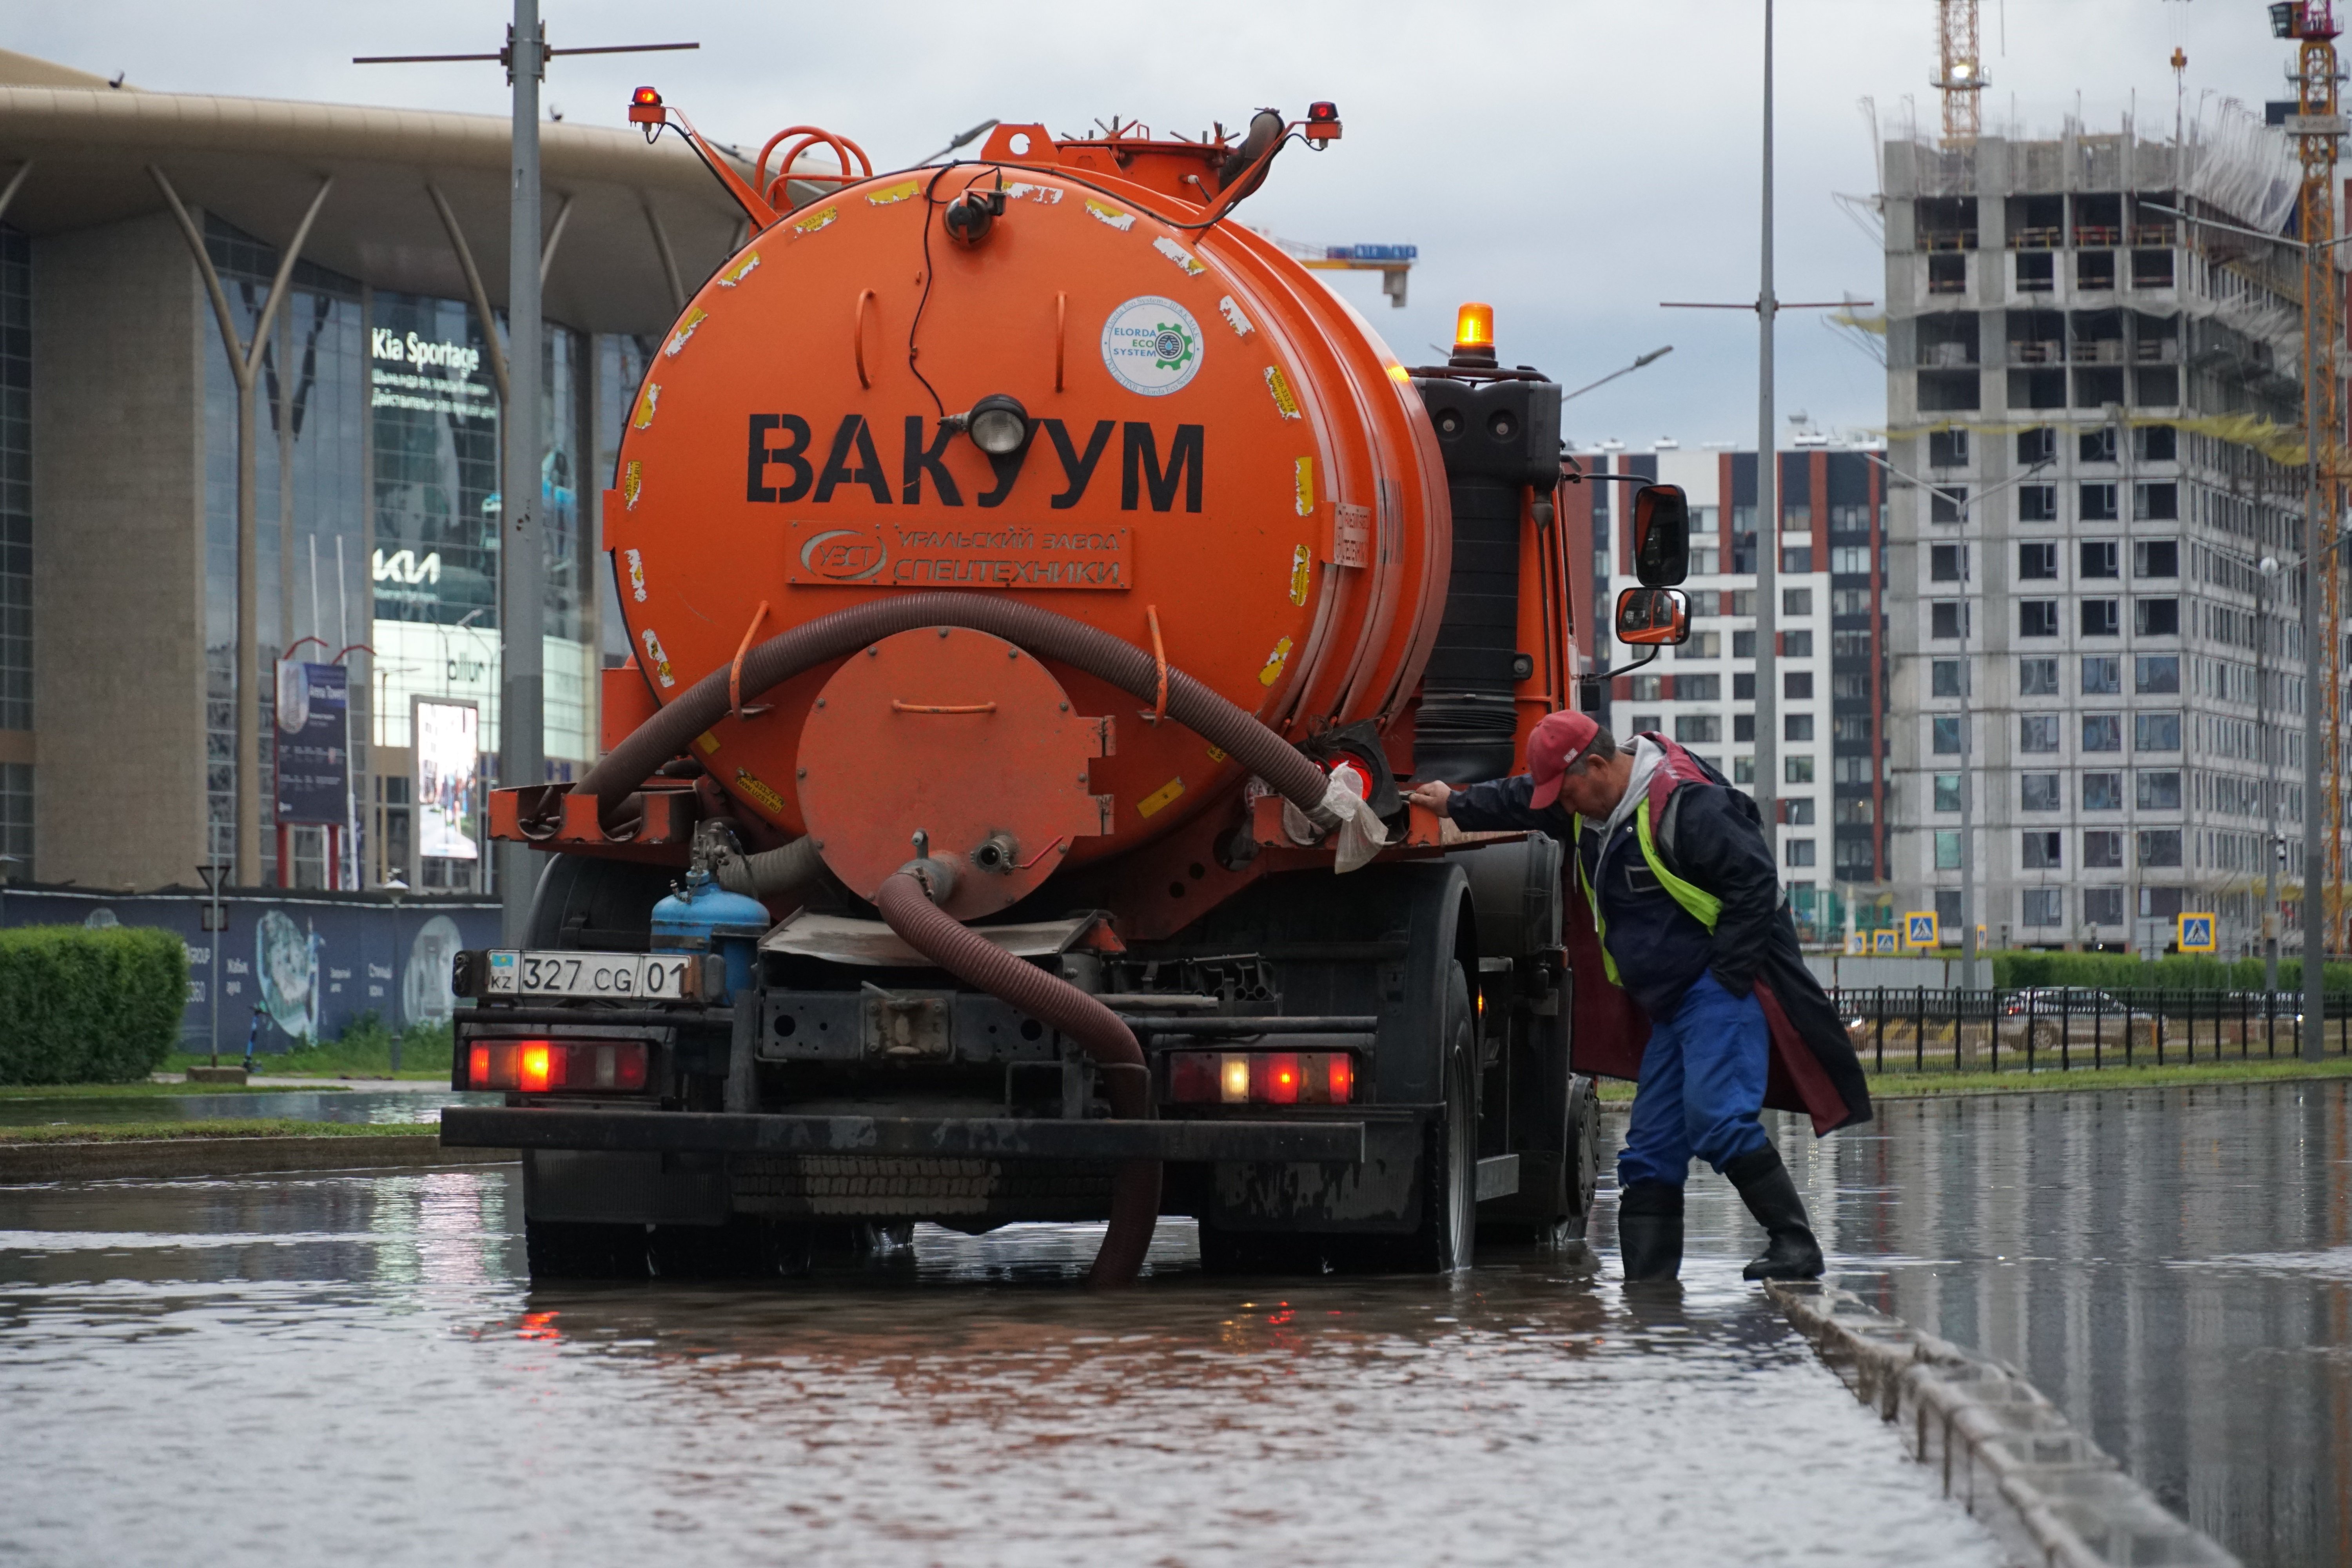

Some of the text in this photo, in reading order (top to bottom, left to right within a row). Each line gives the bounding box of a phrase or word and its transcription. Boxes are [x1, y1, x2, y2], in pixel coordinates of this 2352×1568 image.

[1114, 328, 1157, 338] ELORDA
[1132, 339, 1154, 348] ECO
[372, 328, 479, 379] Kia Sportage
[1114, 348, 1156, 357] SYSTEM
[747, 414, 1204, 513] ВАКУУМ
[899, 528, 1119, 550] УРАЛЬСКИЙ ЗАВОД
[820, 545, 874, 567] УЗСТ
[894, 559, 1119, 584] СПЕЦТЕХНИКИ
[491, 975, 511, 989] KZ
[523, 958, 685, 998] 327 CG 01
